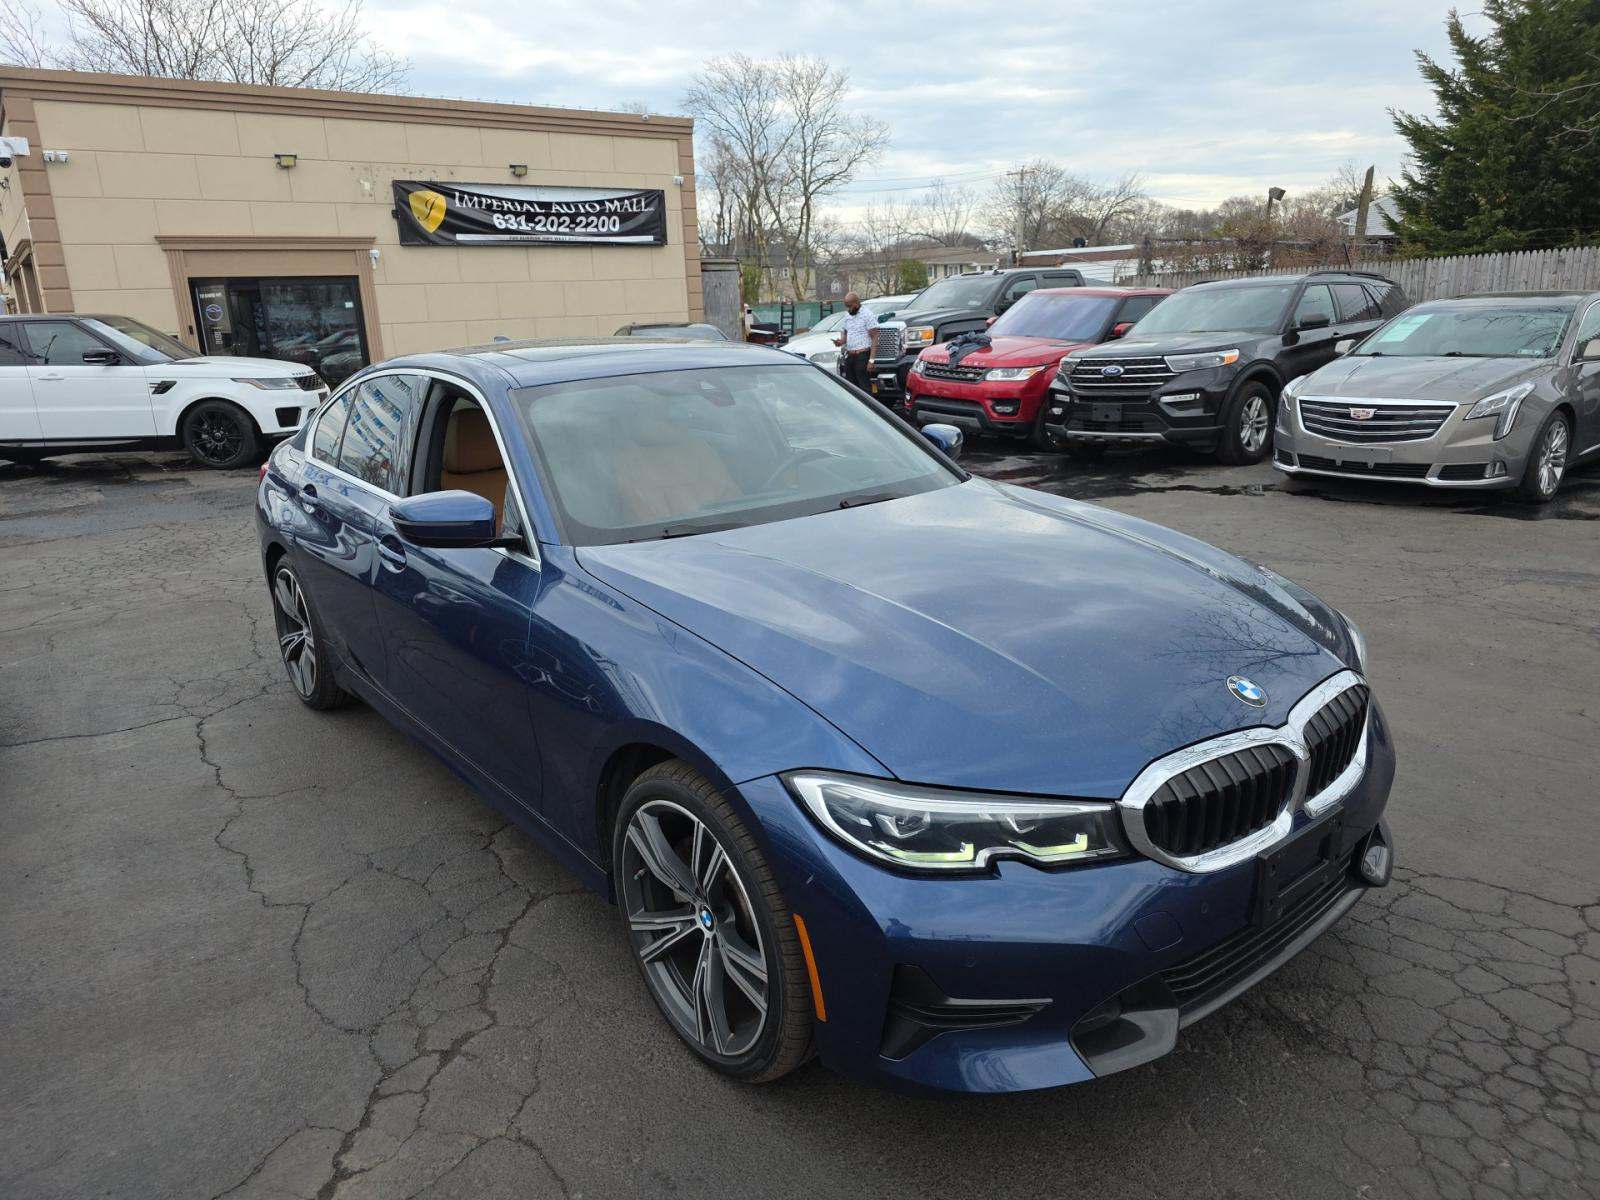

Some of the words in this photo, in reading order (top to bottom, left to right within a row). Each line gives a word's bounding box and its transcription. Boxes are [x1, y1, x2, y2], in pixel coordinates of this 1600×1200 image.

[454, 191, 545, 213] IMPERIAL
[551, 202, 600, 213] AUTO
[604, 197, 655, 212] MALL
[493, 213, 620, 232] 631-202-2200
